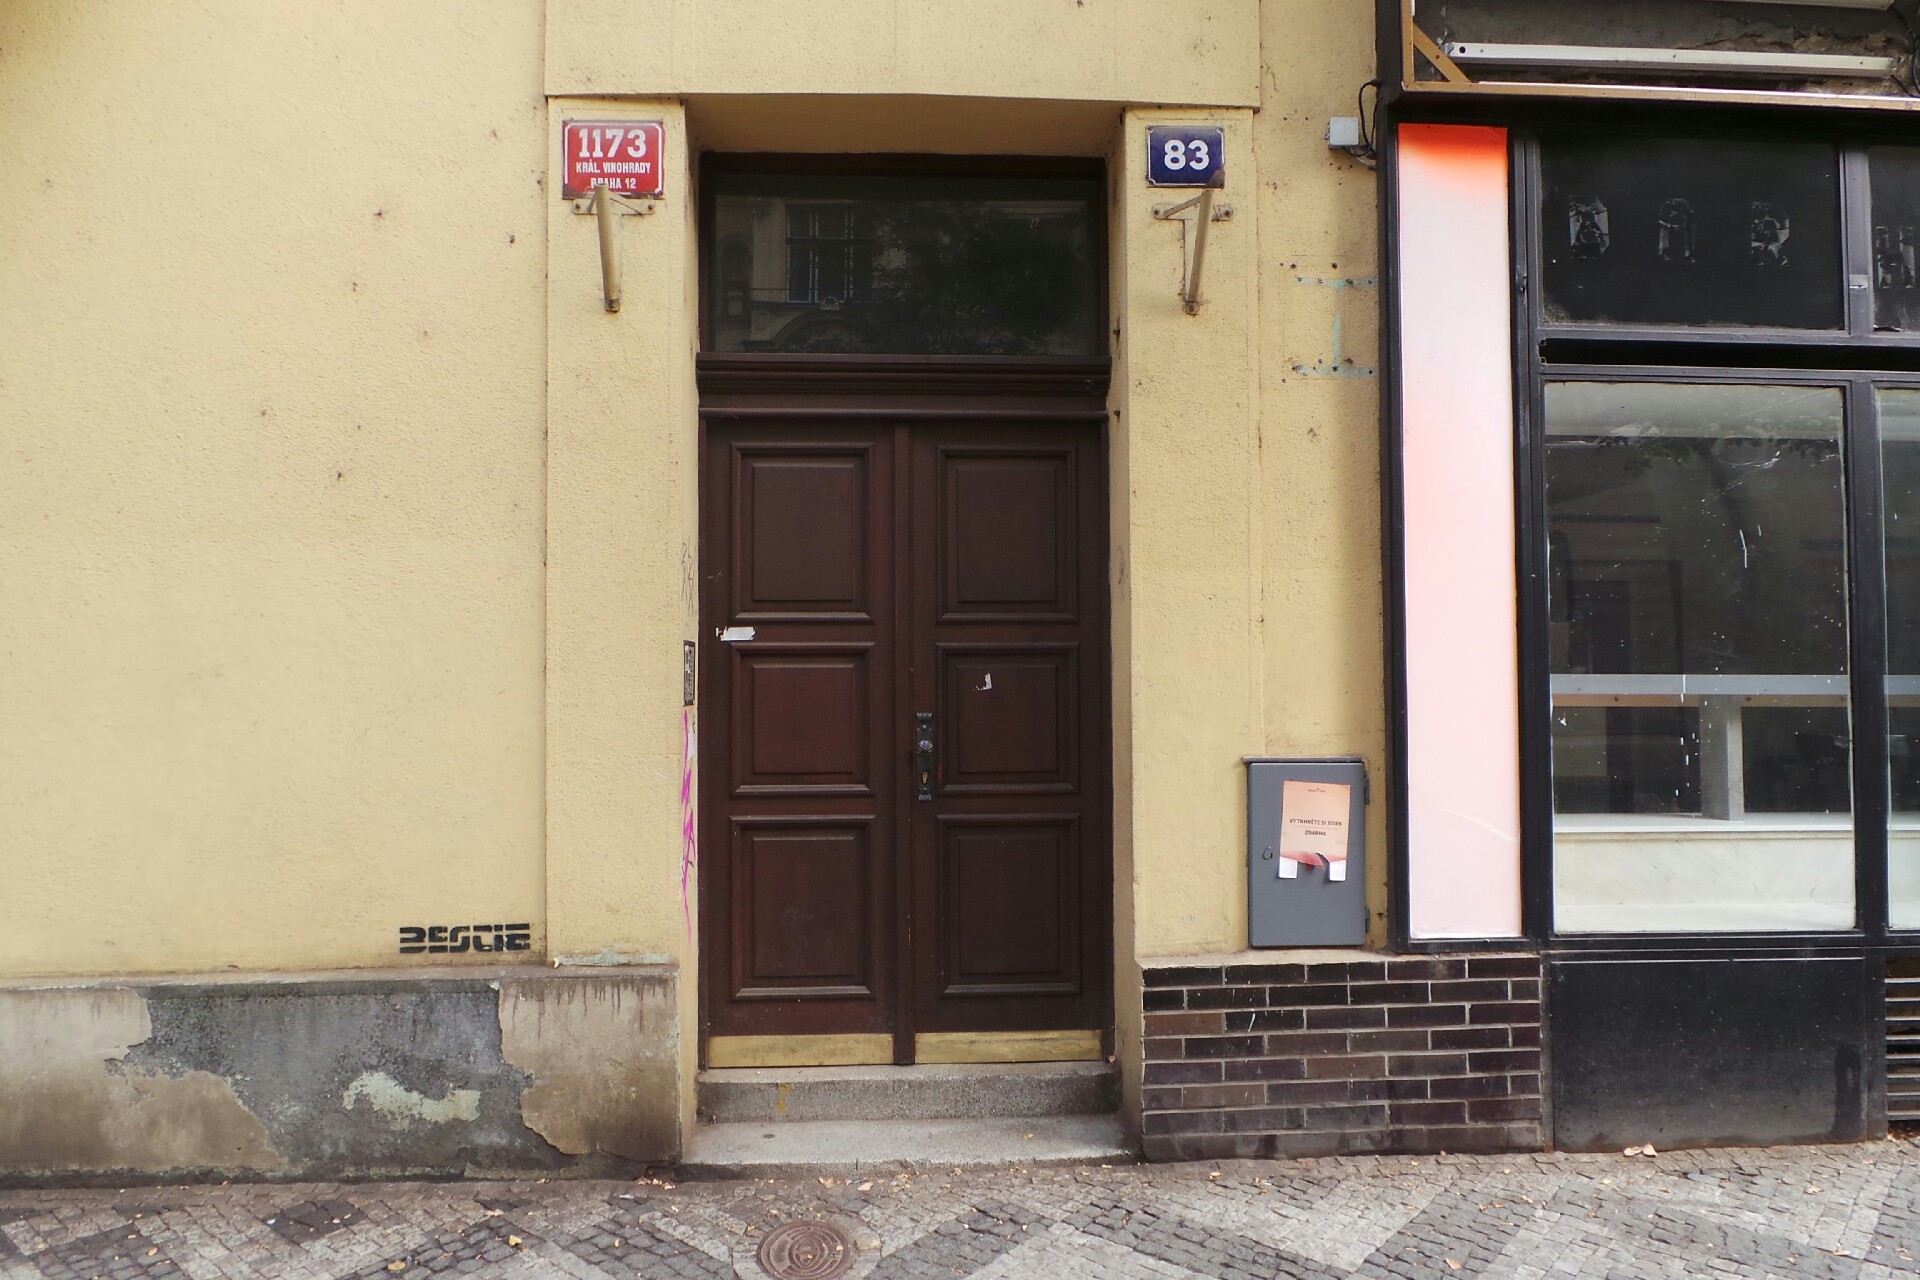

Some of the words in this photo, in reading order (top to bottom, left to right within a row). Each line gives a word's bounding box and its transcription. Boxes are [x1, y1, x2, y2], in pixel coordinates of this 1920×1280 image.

[578, 128, 647, 158] 1173
[1164, 139, 1210, 170] 83
[602, 161, 651, 174] VINOHRADY
[624, 177, 636, 189] 12
